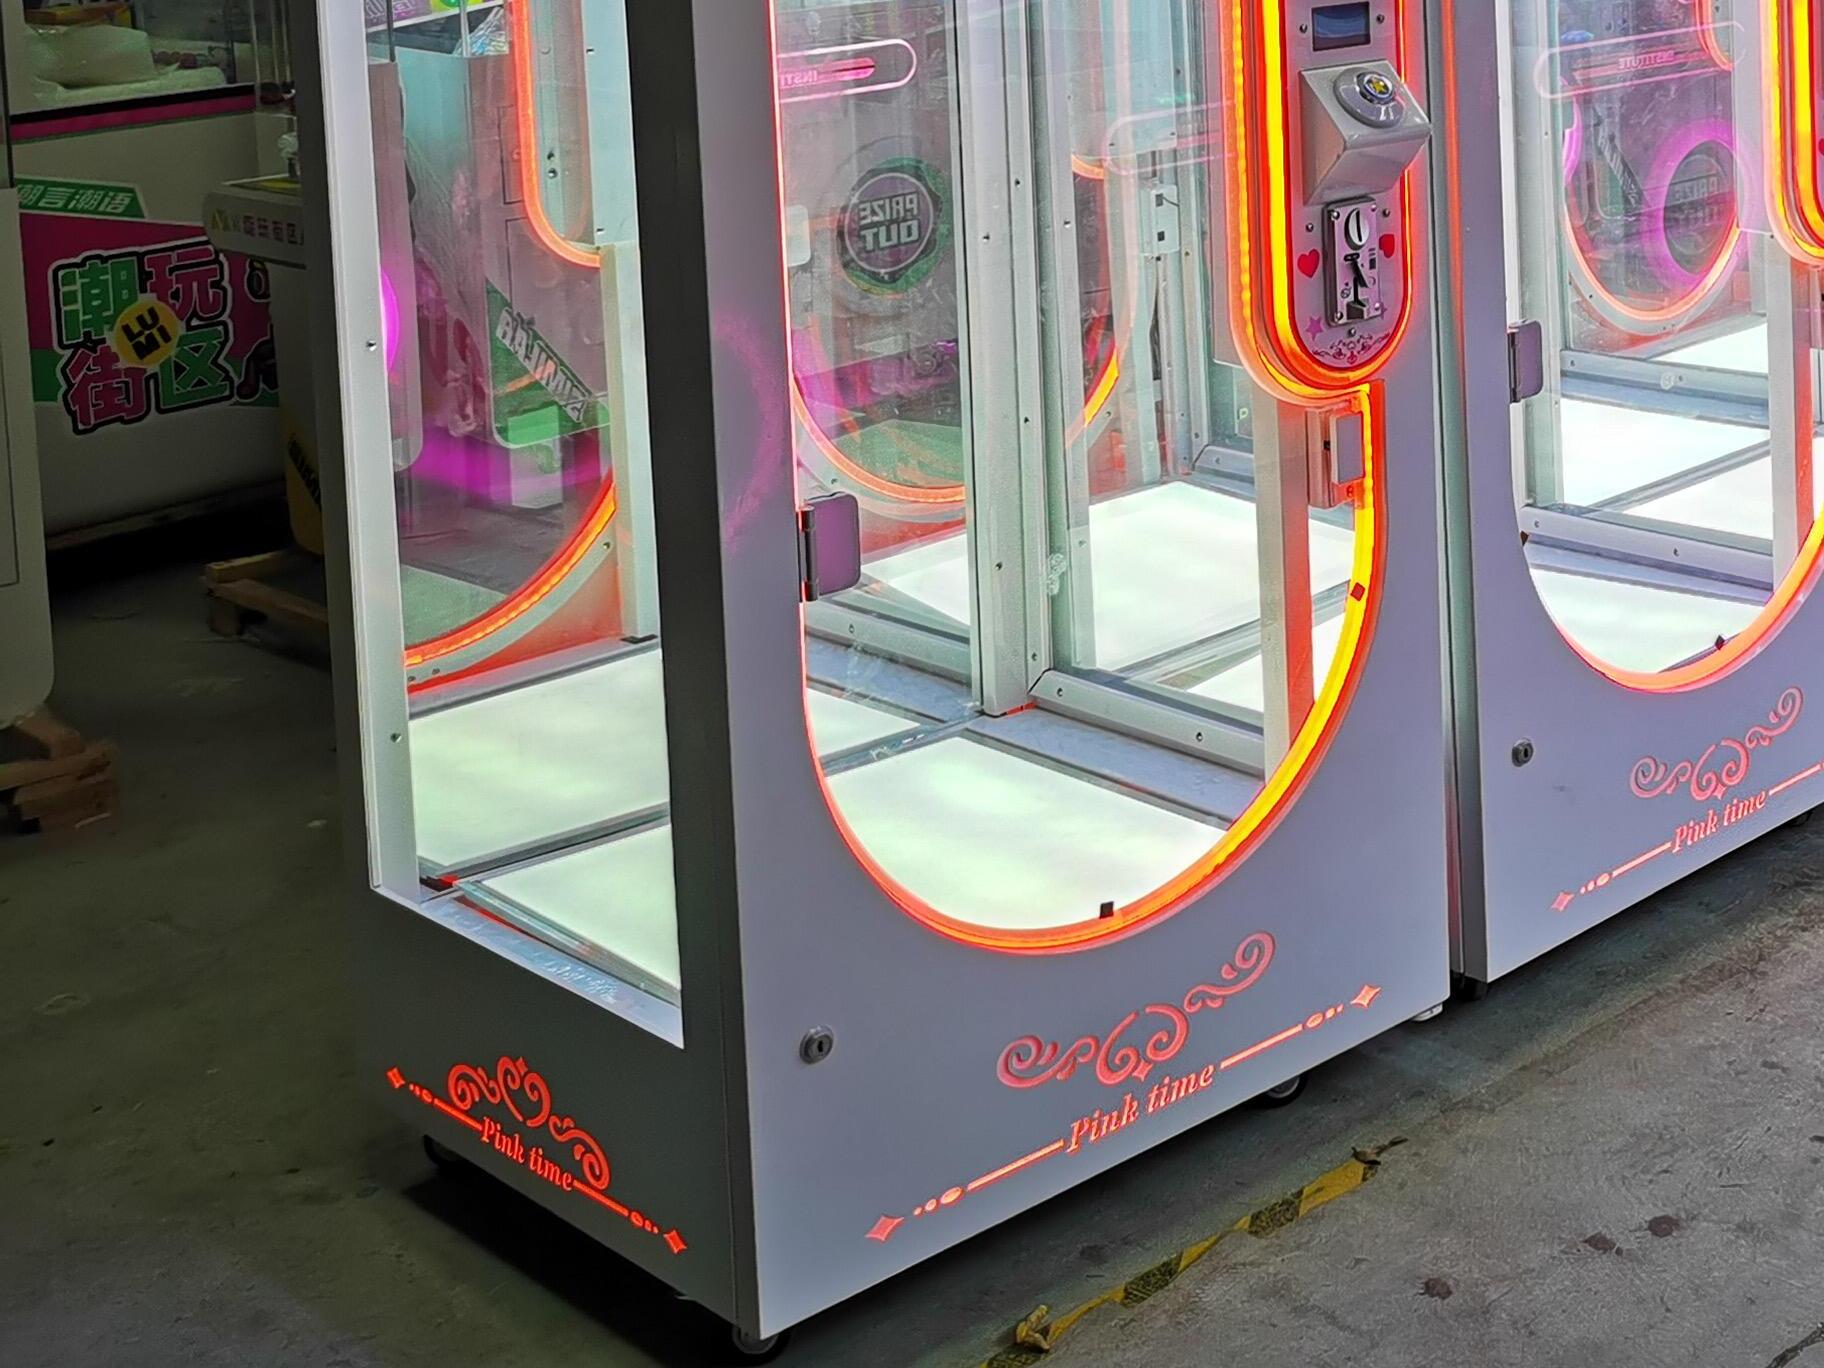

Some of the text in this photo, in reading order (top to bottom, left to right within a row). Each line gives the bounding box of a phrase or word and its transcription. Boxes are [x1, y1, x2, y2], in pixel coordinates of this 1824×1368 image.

[1671, 789, 1768, 854] Pink time
[1065, 1062, 1216, 1154] Pink time
[480, 1116, 575, 1192] Pink time
